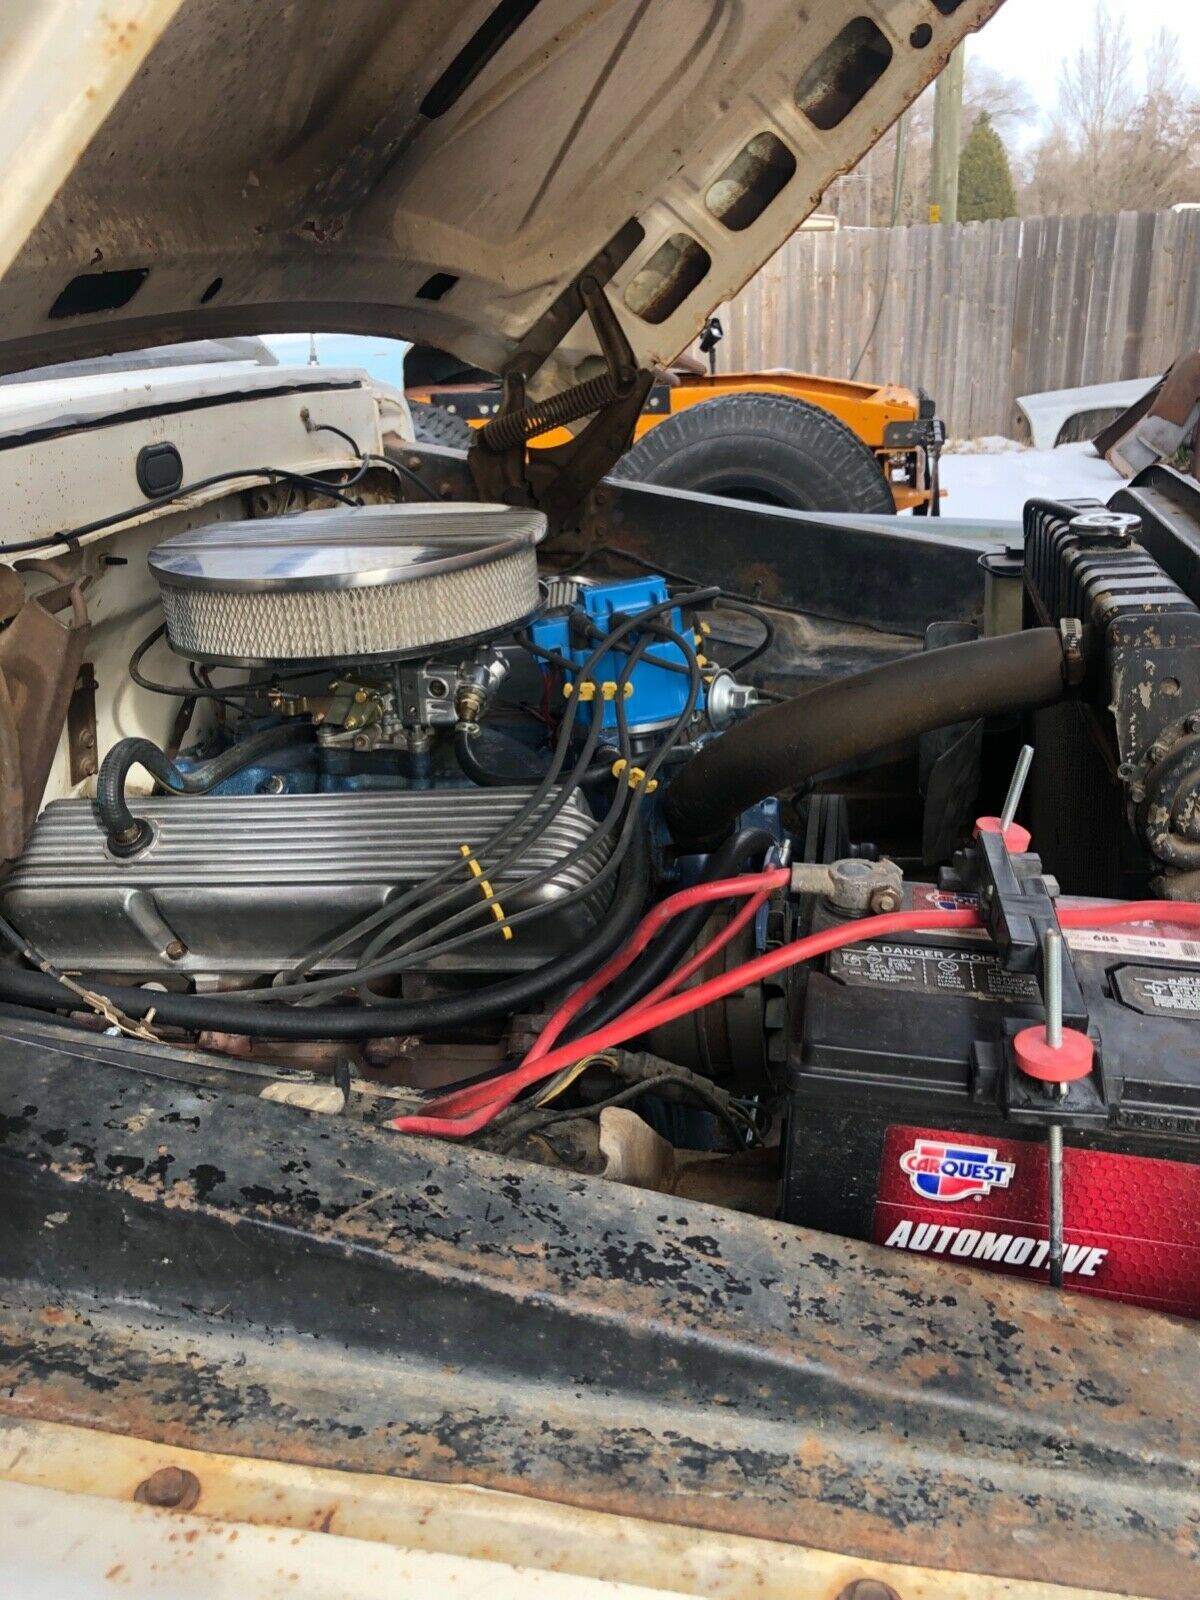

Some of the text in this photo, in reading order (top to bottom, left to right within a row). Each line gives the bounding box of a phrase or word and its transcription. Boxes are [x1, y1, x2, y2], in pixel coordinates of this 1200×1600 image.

[882, 946, 944, 959] DANGER
[960, 953, 1001, 963] POIS
[906, 1155, 1007, 1182] CARQUEST
